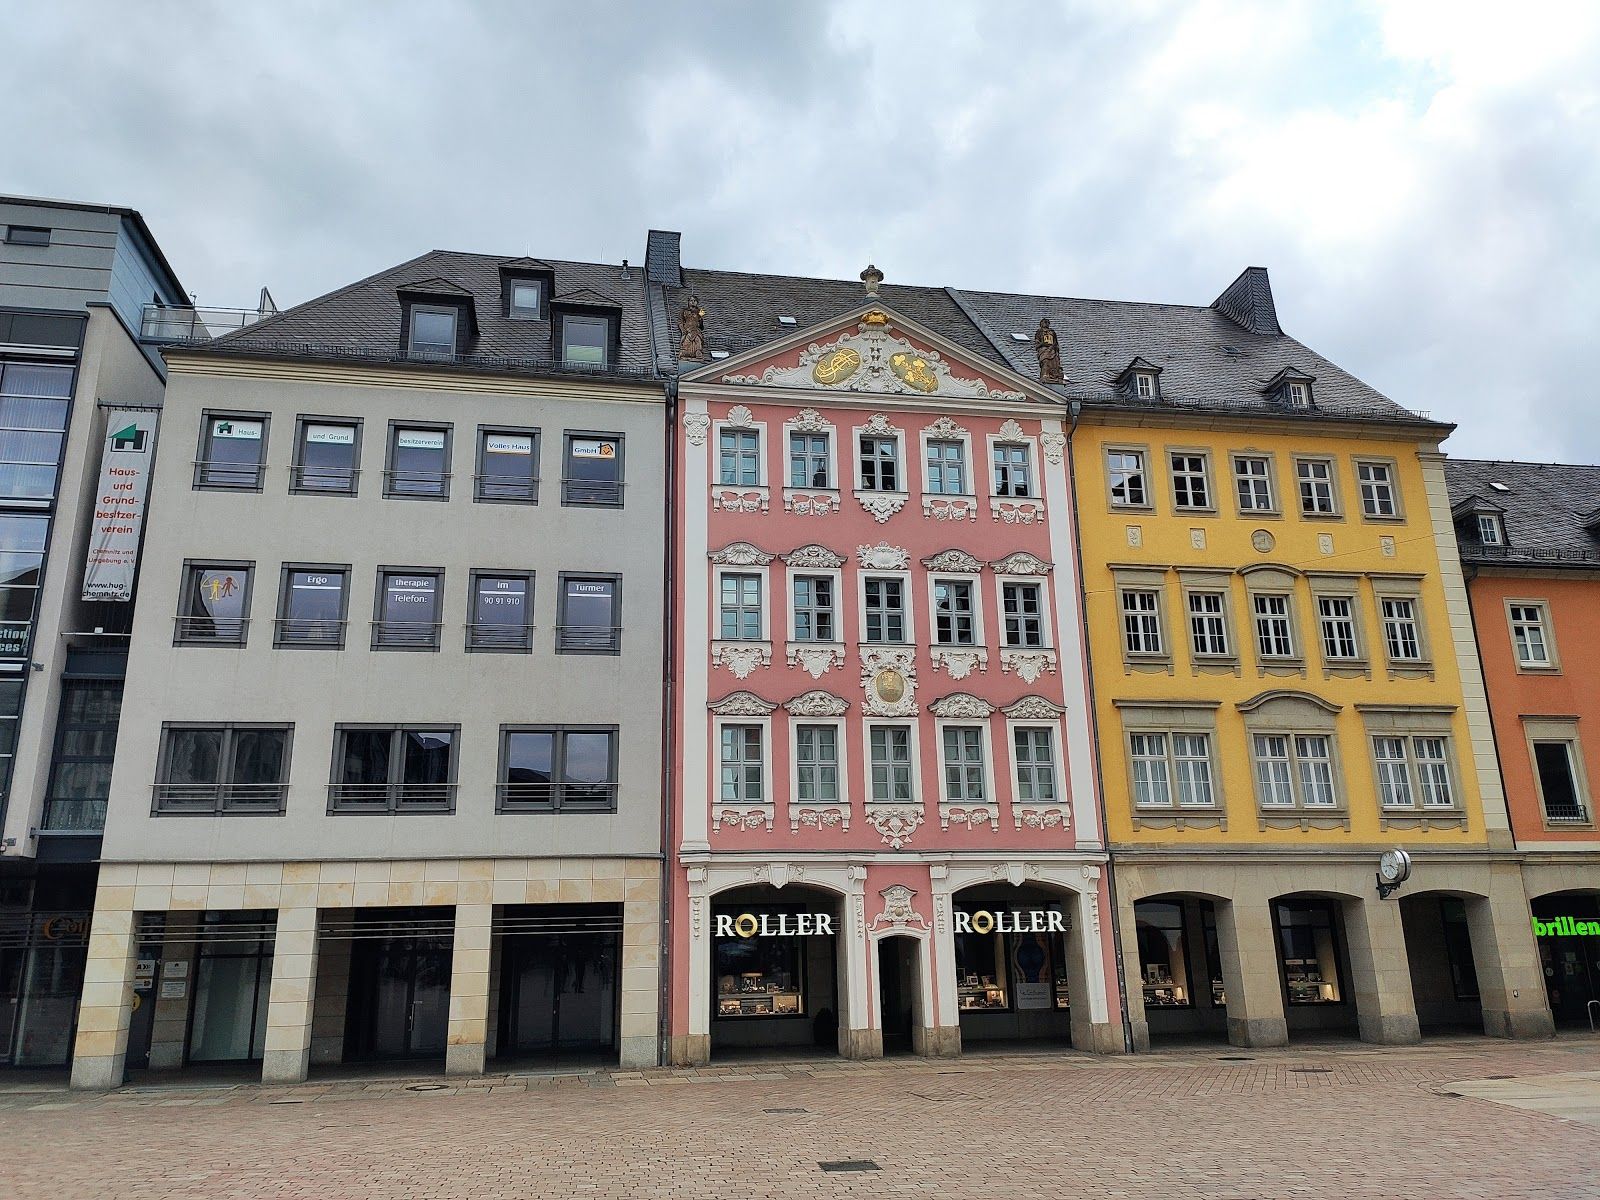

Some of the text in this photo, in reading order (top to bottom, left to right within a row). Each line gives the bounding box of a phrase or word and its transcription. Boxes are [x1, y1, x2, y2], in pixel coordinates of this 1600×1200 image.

[238, 429, 259, 437] Haus-
[328, 433, 349, 441] Grund
[400, 438, 443, 446] besitzerverein
[488, 442, 510, 450] Volles
[109, 467, 141, 477] Haus-
[113, 482, 133, 491] und
[102, 496, 140, 506] Grund-
[96, 510, 141, 520] besitzer-
[101, 525, 133, 534] verein
[306, 575, 328, 585] Ergo
[395, 578, 430, 588] therapie
[394, 594, 428, 603] Telefon:
[484, 596, 494, 604] 90
[495, 597, 504, 605] 91
[715, 913, 835, 938] ROLLER
[953, 910, 1067, 935] ROLLER
[1531, 916, 1600, 936] brillen
